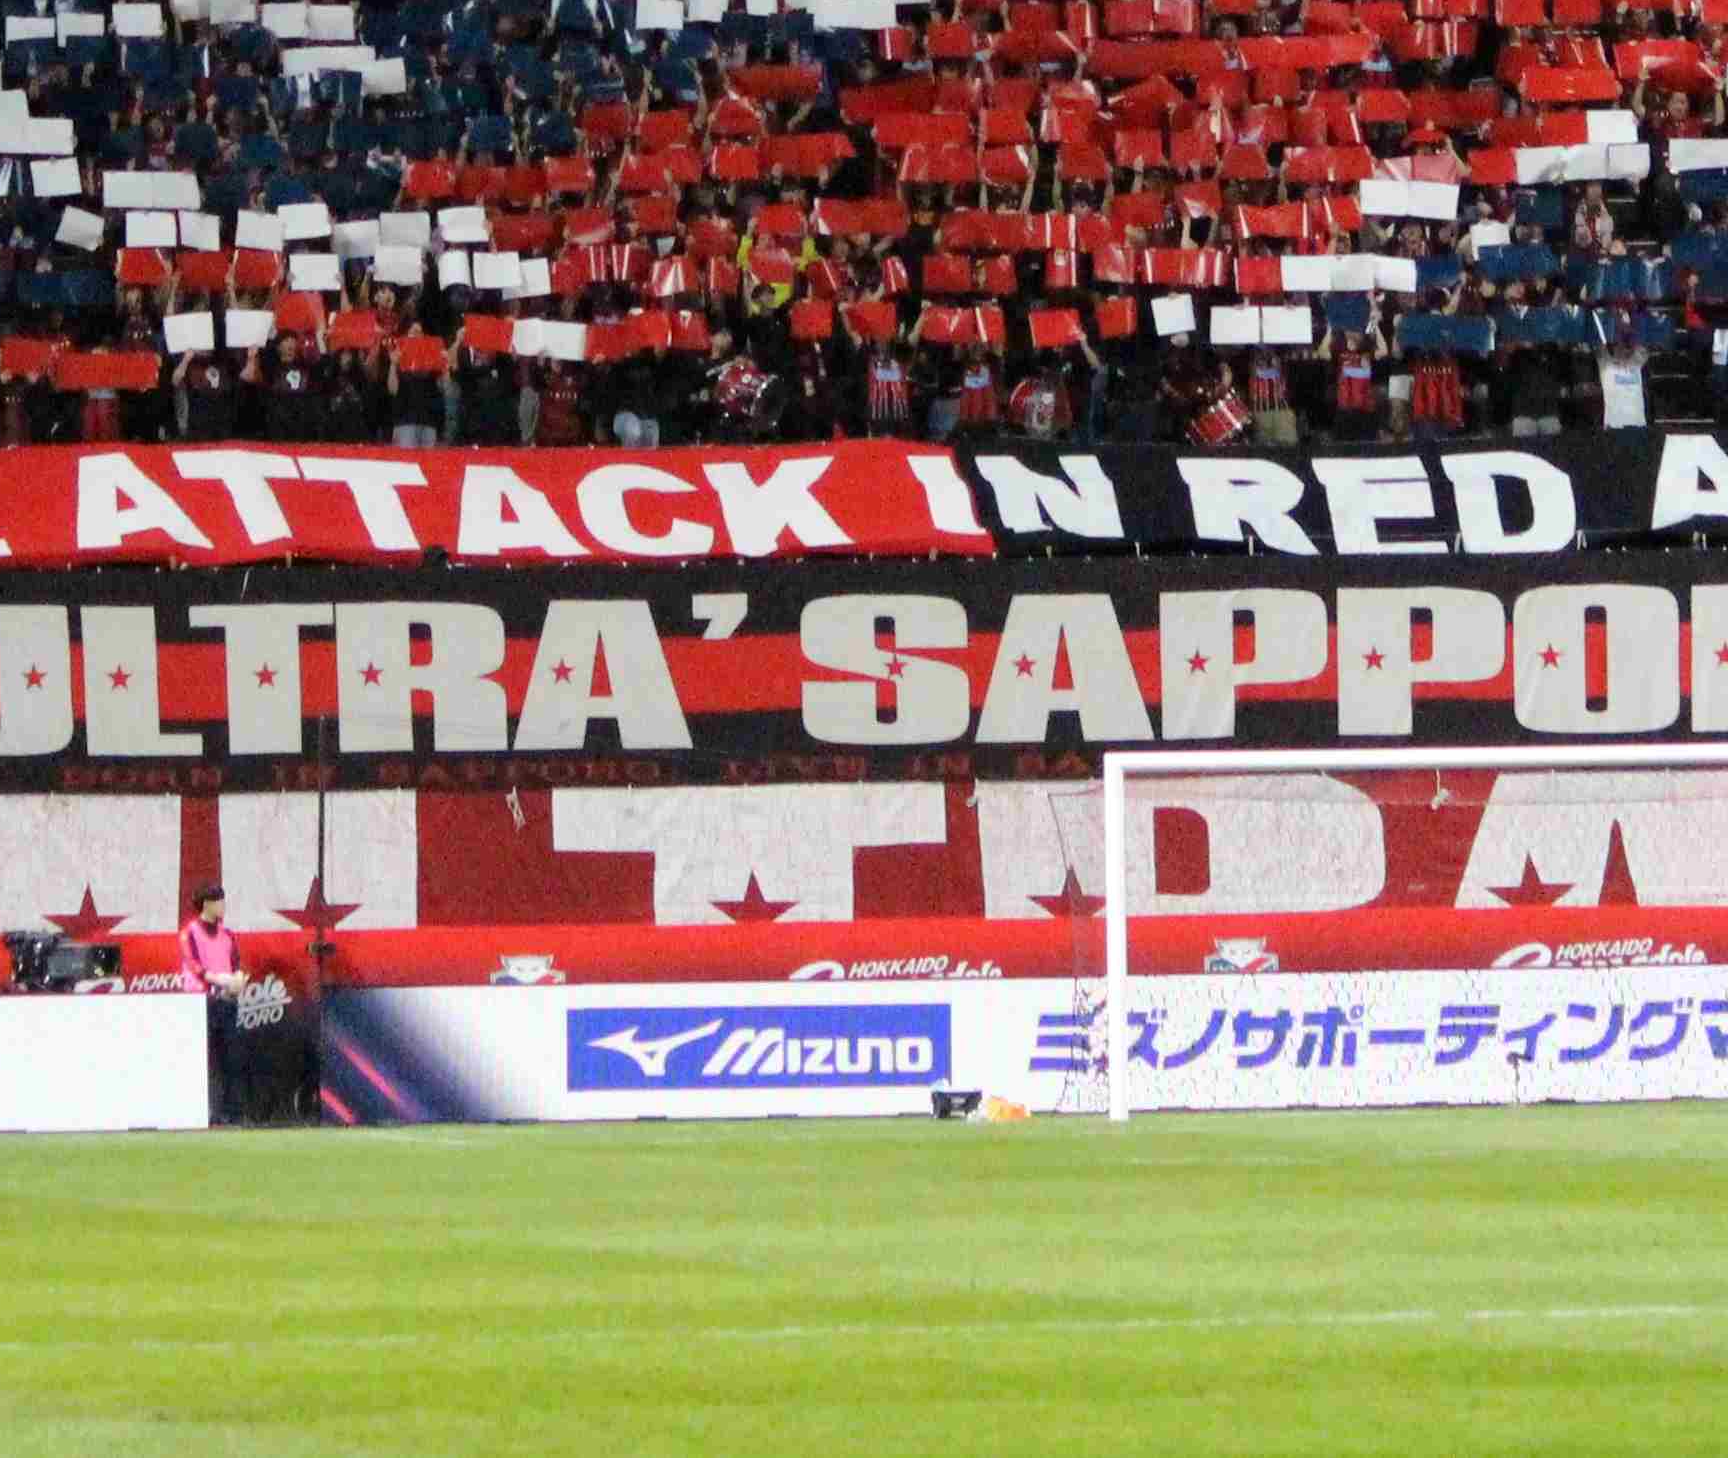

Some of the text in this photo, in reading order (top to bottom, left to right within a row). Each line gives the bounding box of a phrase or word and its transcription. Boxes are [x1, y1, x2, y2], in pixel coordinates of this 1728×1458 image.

[76, 449, 856, 557] ATTACK
[908, 454, 1123, 540] IN
[1177, 450, 1576, 556] RED
[1556, 937, 1654, 961] HOKKAIDO
[849, 955, 949, 979] HOKKAIDO
